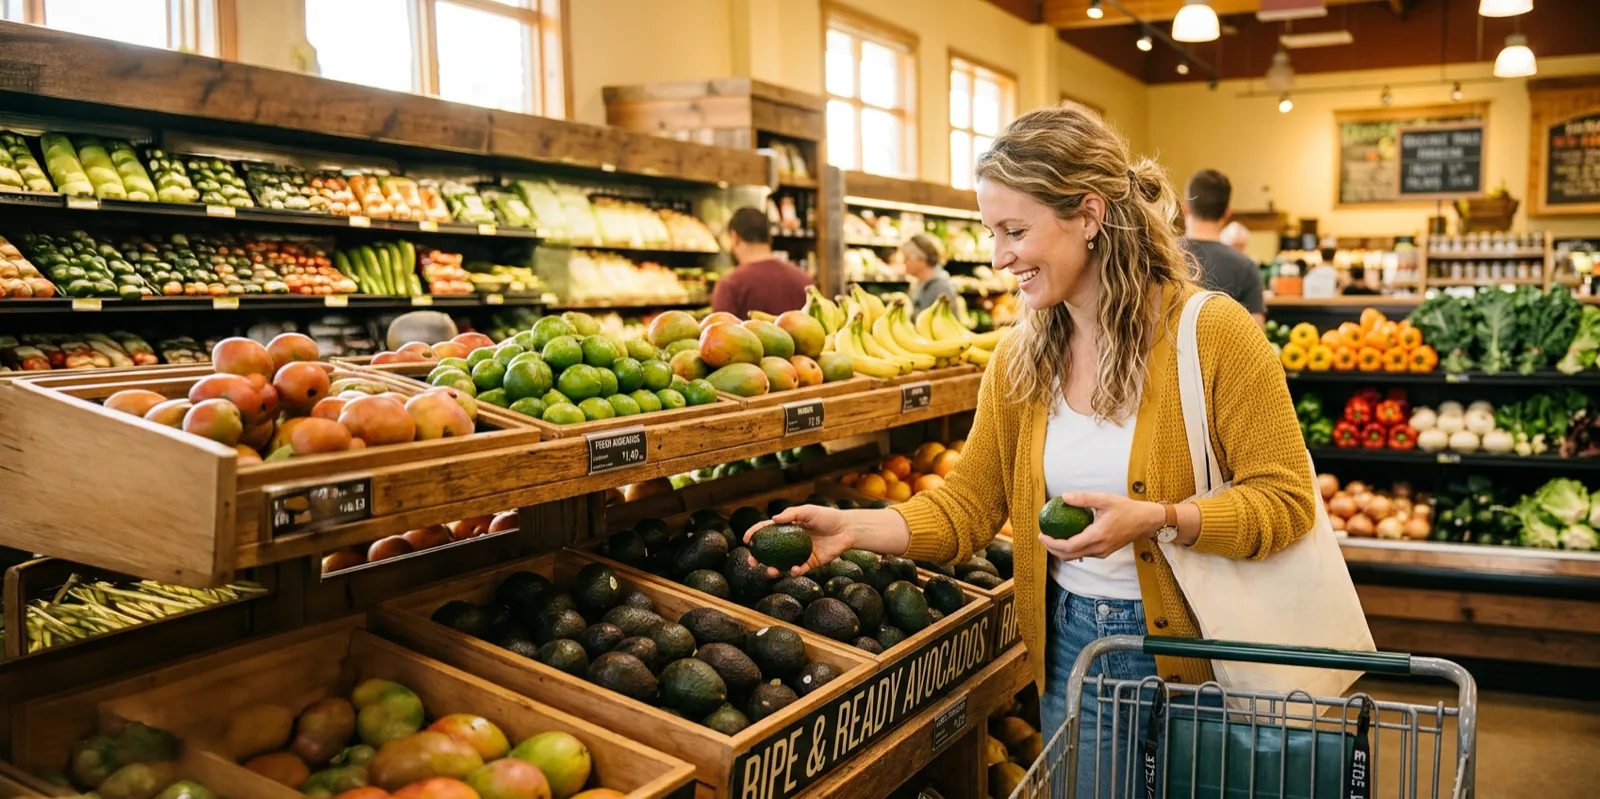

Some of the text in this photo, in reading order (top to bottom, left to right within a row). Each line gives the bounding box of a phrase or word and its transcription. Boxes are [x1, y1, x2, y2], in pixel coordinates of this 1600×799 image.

[742, 616, 988, 799] RIPE & READY AVOCADOS
